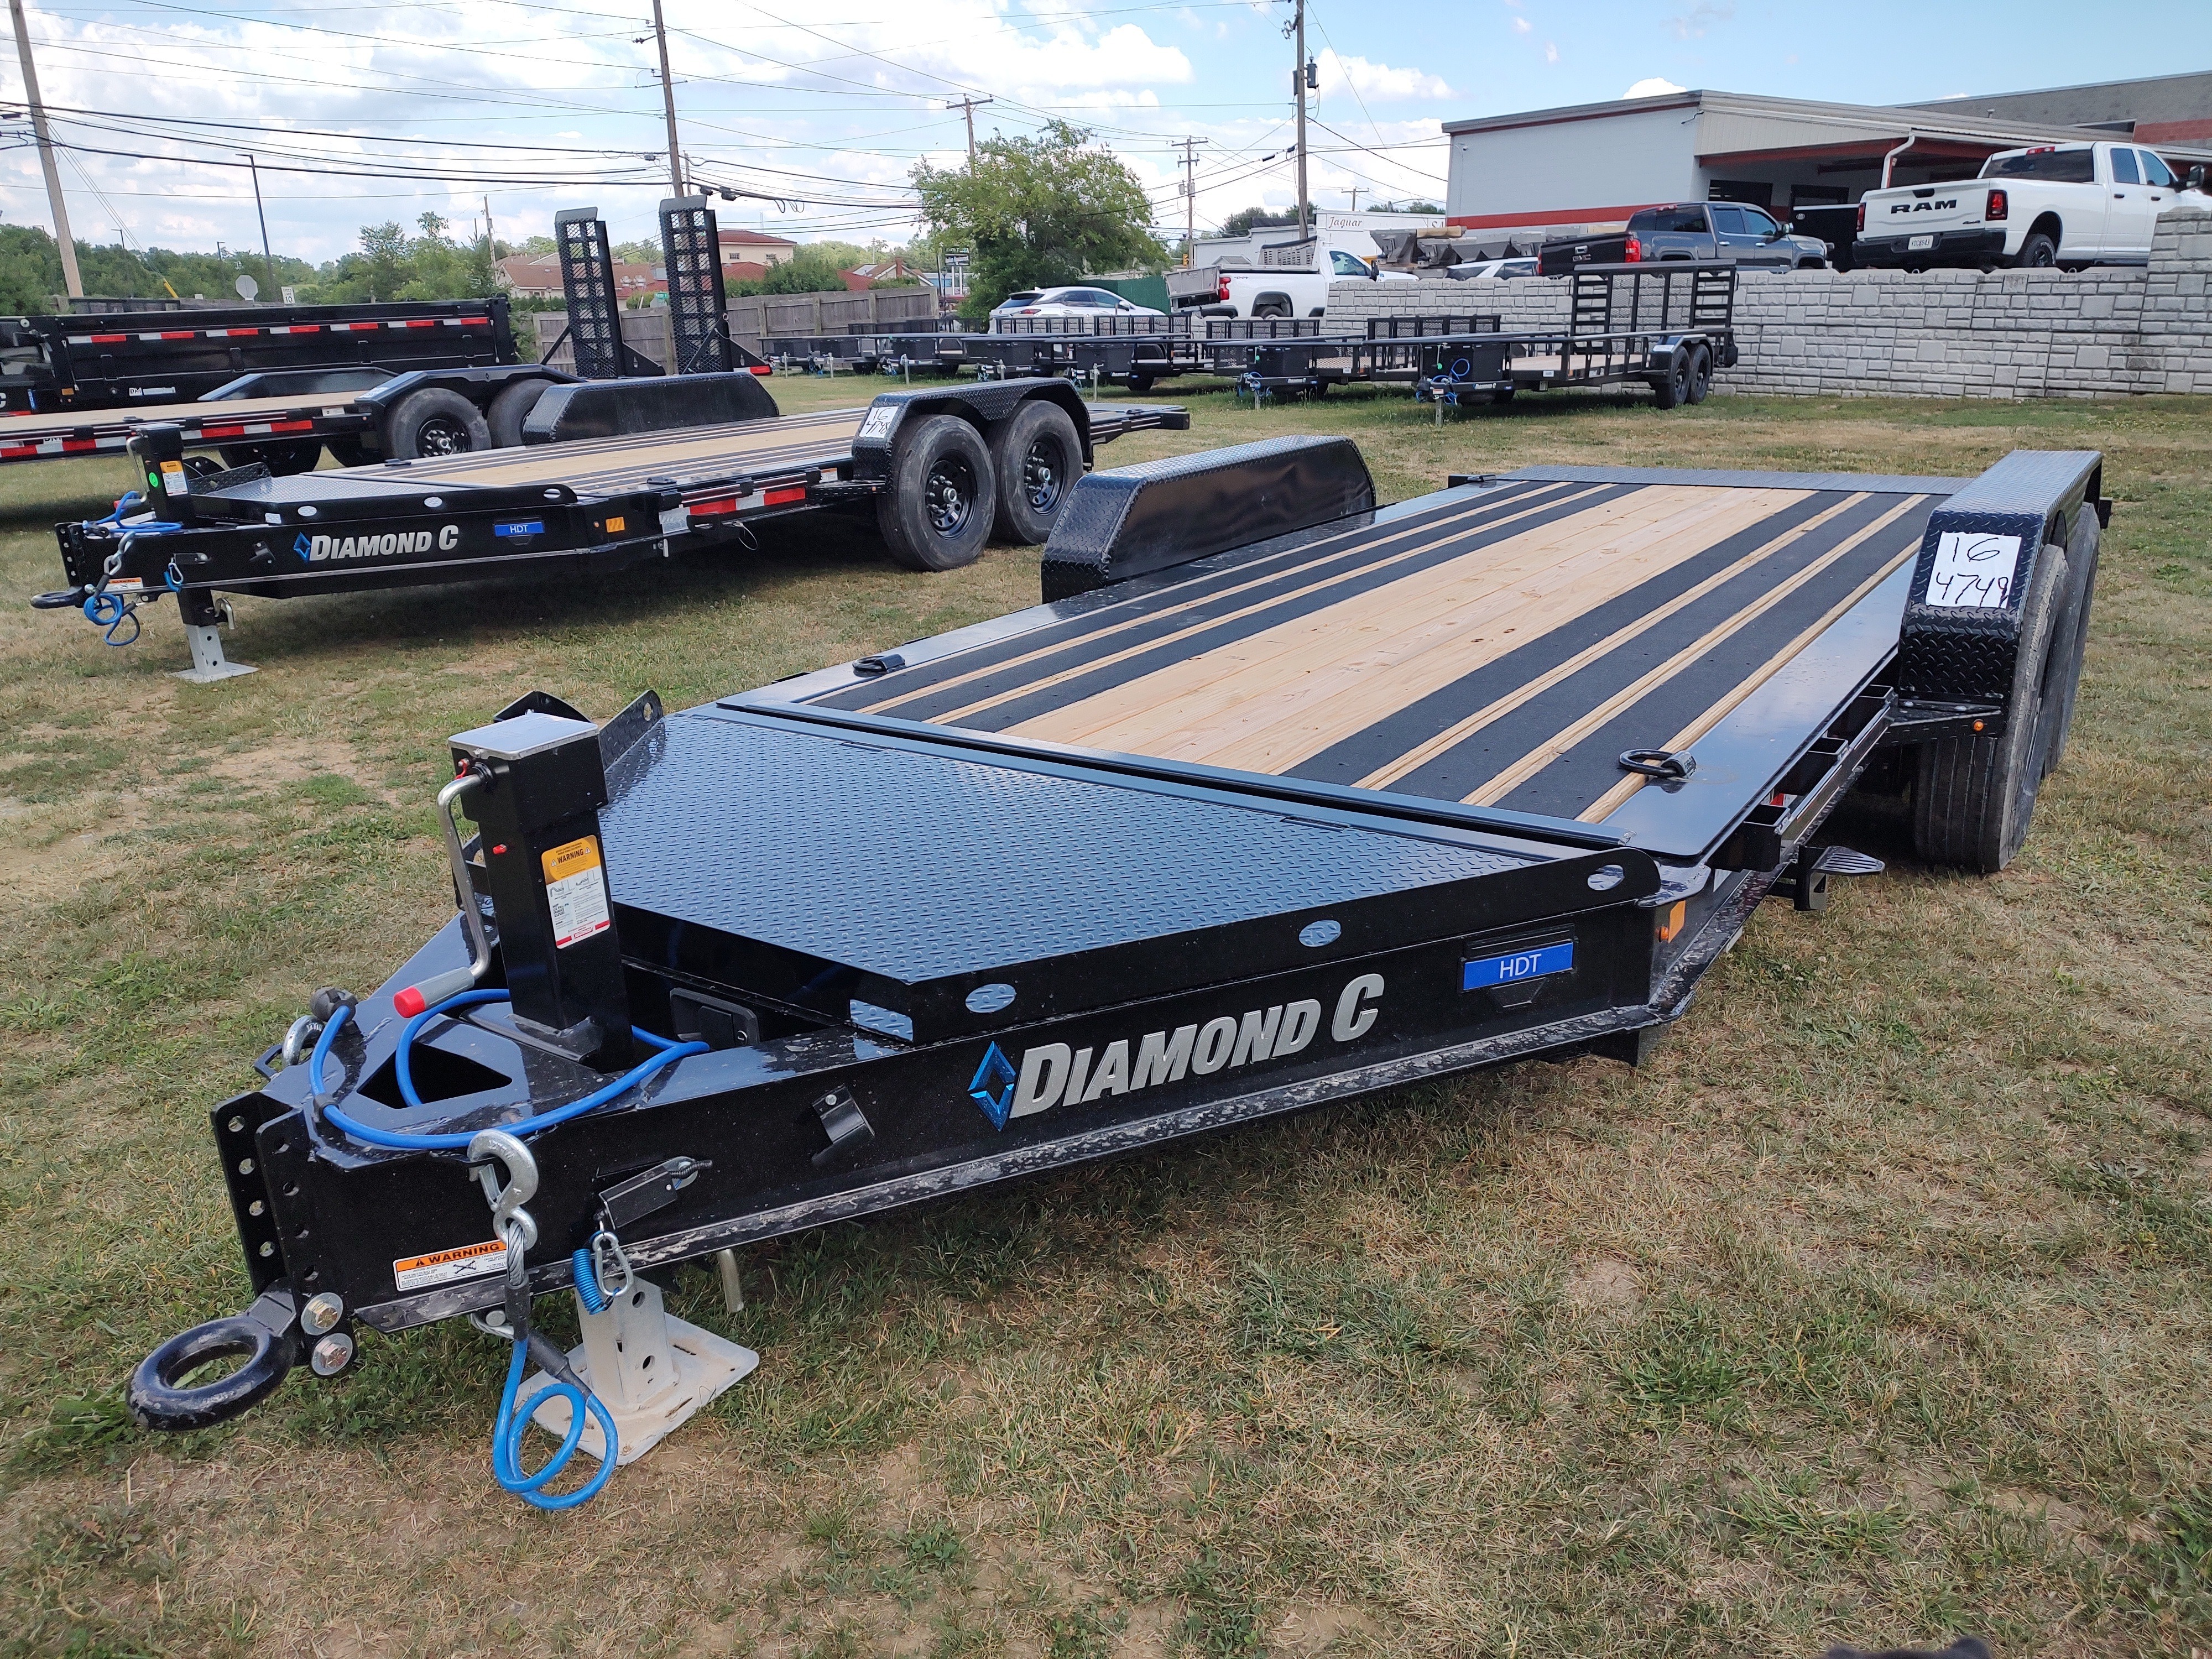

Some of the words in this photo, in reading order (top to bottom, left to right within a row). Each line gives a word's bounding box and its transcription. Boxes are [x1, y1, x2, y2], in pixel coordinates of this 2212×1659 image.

[1890, 199, 1957, 214] RAM
[1328, 216, 1363, 228] Jaguar
[873, 408, 891, 420] 16
[509, 524, 528, 534] HDT
[309, 531, 432, 561] DIAMOND
[439, 525, 458, 550] C
[1952, 537, 2000, 562] 16
[557, 848, 584, 864] WARNING
[1499, 953, 1542, 979] HDT
[1009, 999, 1321, 1119] DIAMOND
[1331, 973, 1384, 1042] C
[428, 1244, 499, 1264] WARNING
